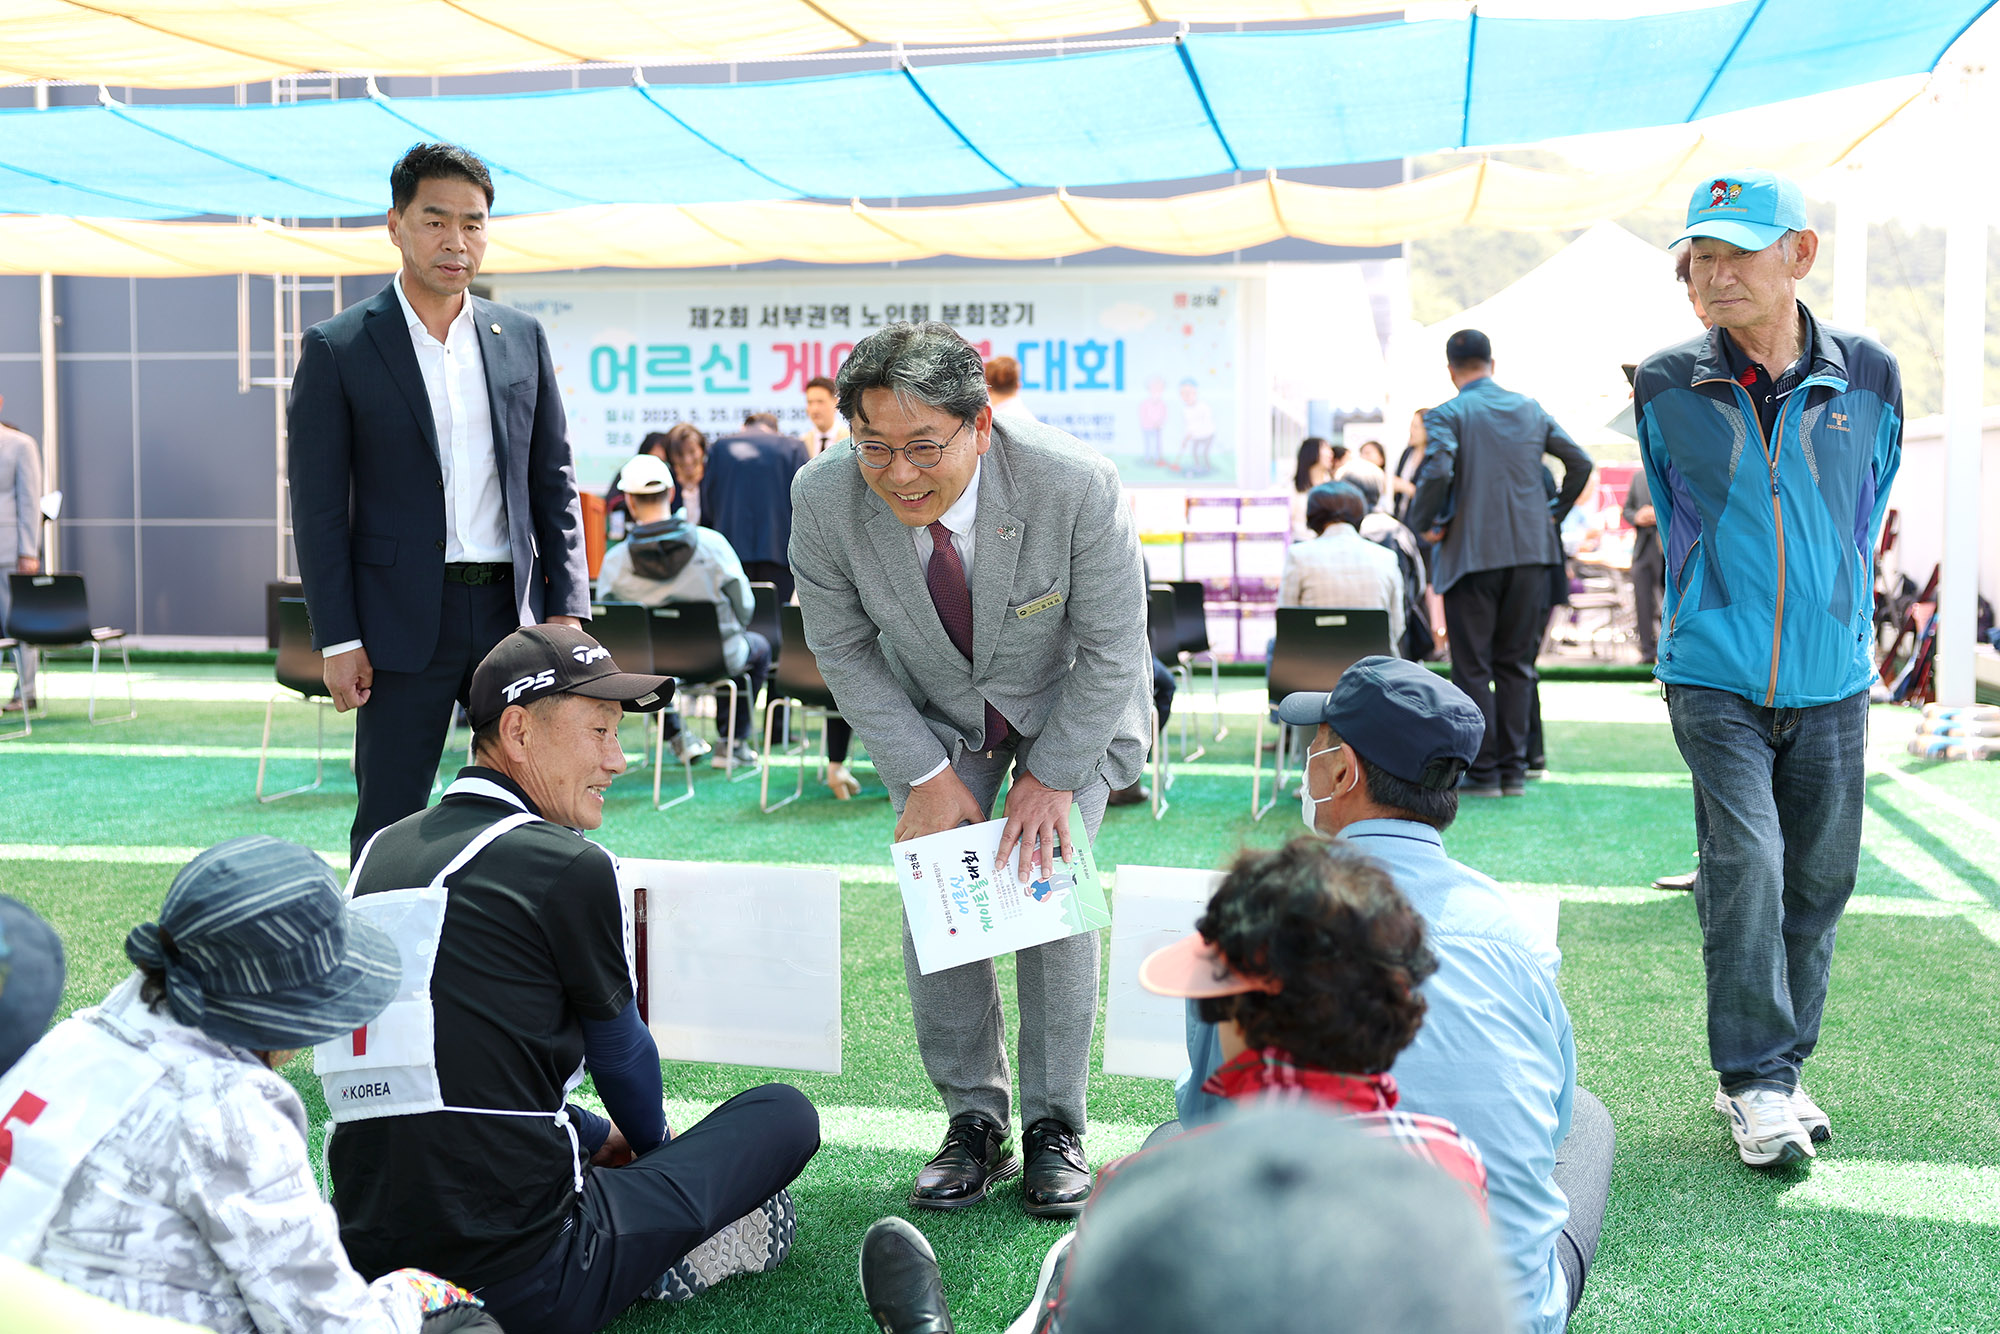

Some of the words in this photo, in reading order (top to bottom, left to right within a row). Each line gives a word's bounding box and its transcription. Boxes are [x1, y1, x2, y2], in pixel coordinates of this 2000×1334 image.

[689, 305, 749, 329] 제2회
[758, 304, 851, 328] 서부권역
[861, 303, 930, 326] 노인회
[941, 302, 1034, 326] 분회장기
[590, 341, 751, 395] 어르신
[1016, 339, 1125, 392] 대회
[501, 668, 556, 703] TP5
[950, 875, 969, 914] 어르신
[350, 1082, 391, 1099] KOREA
